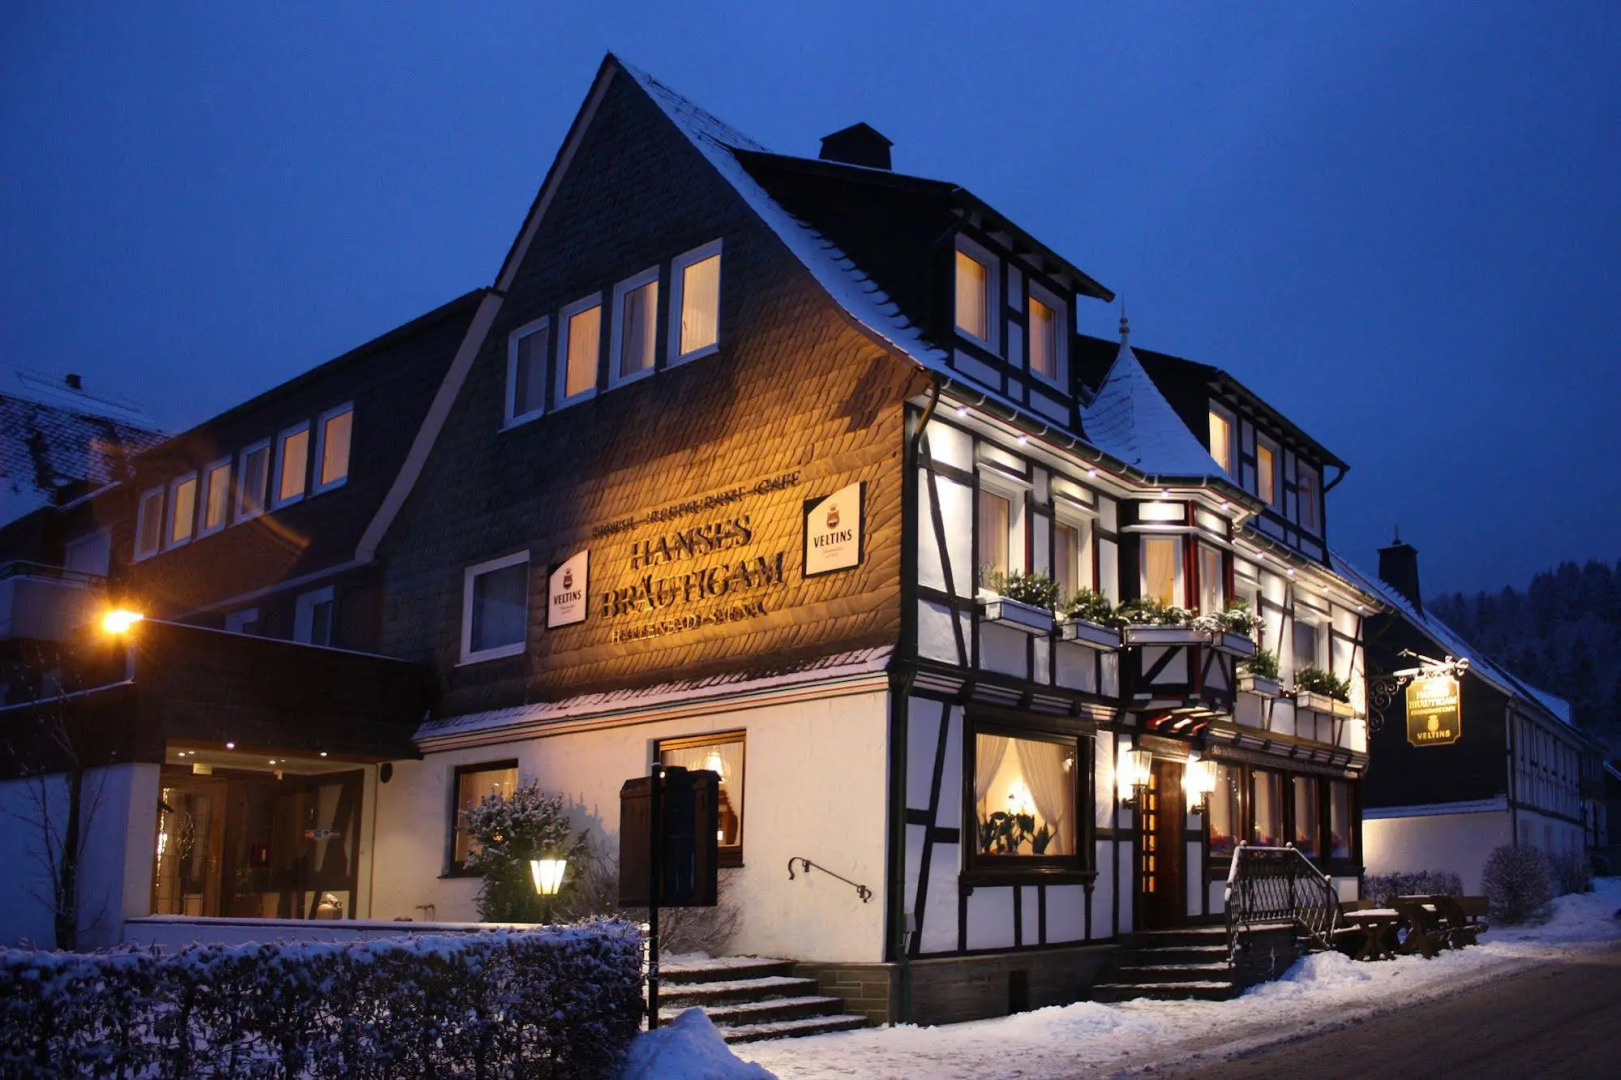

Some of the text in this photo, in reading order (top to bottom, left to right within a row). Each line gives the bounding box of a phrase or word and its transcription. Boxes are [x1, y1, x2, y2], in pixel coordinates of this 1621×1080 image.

[630, 513, 752, 571] HANSES
[814, 529, 853, 548] VELTINS
[553, 590, 582, 606] VELTINS
[611, 613, 699, 645] HALLENBAD
[1416, 730, 1451, 740] VELTINS
